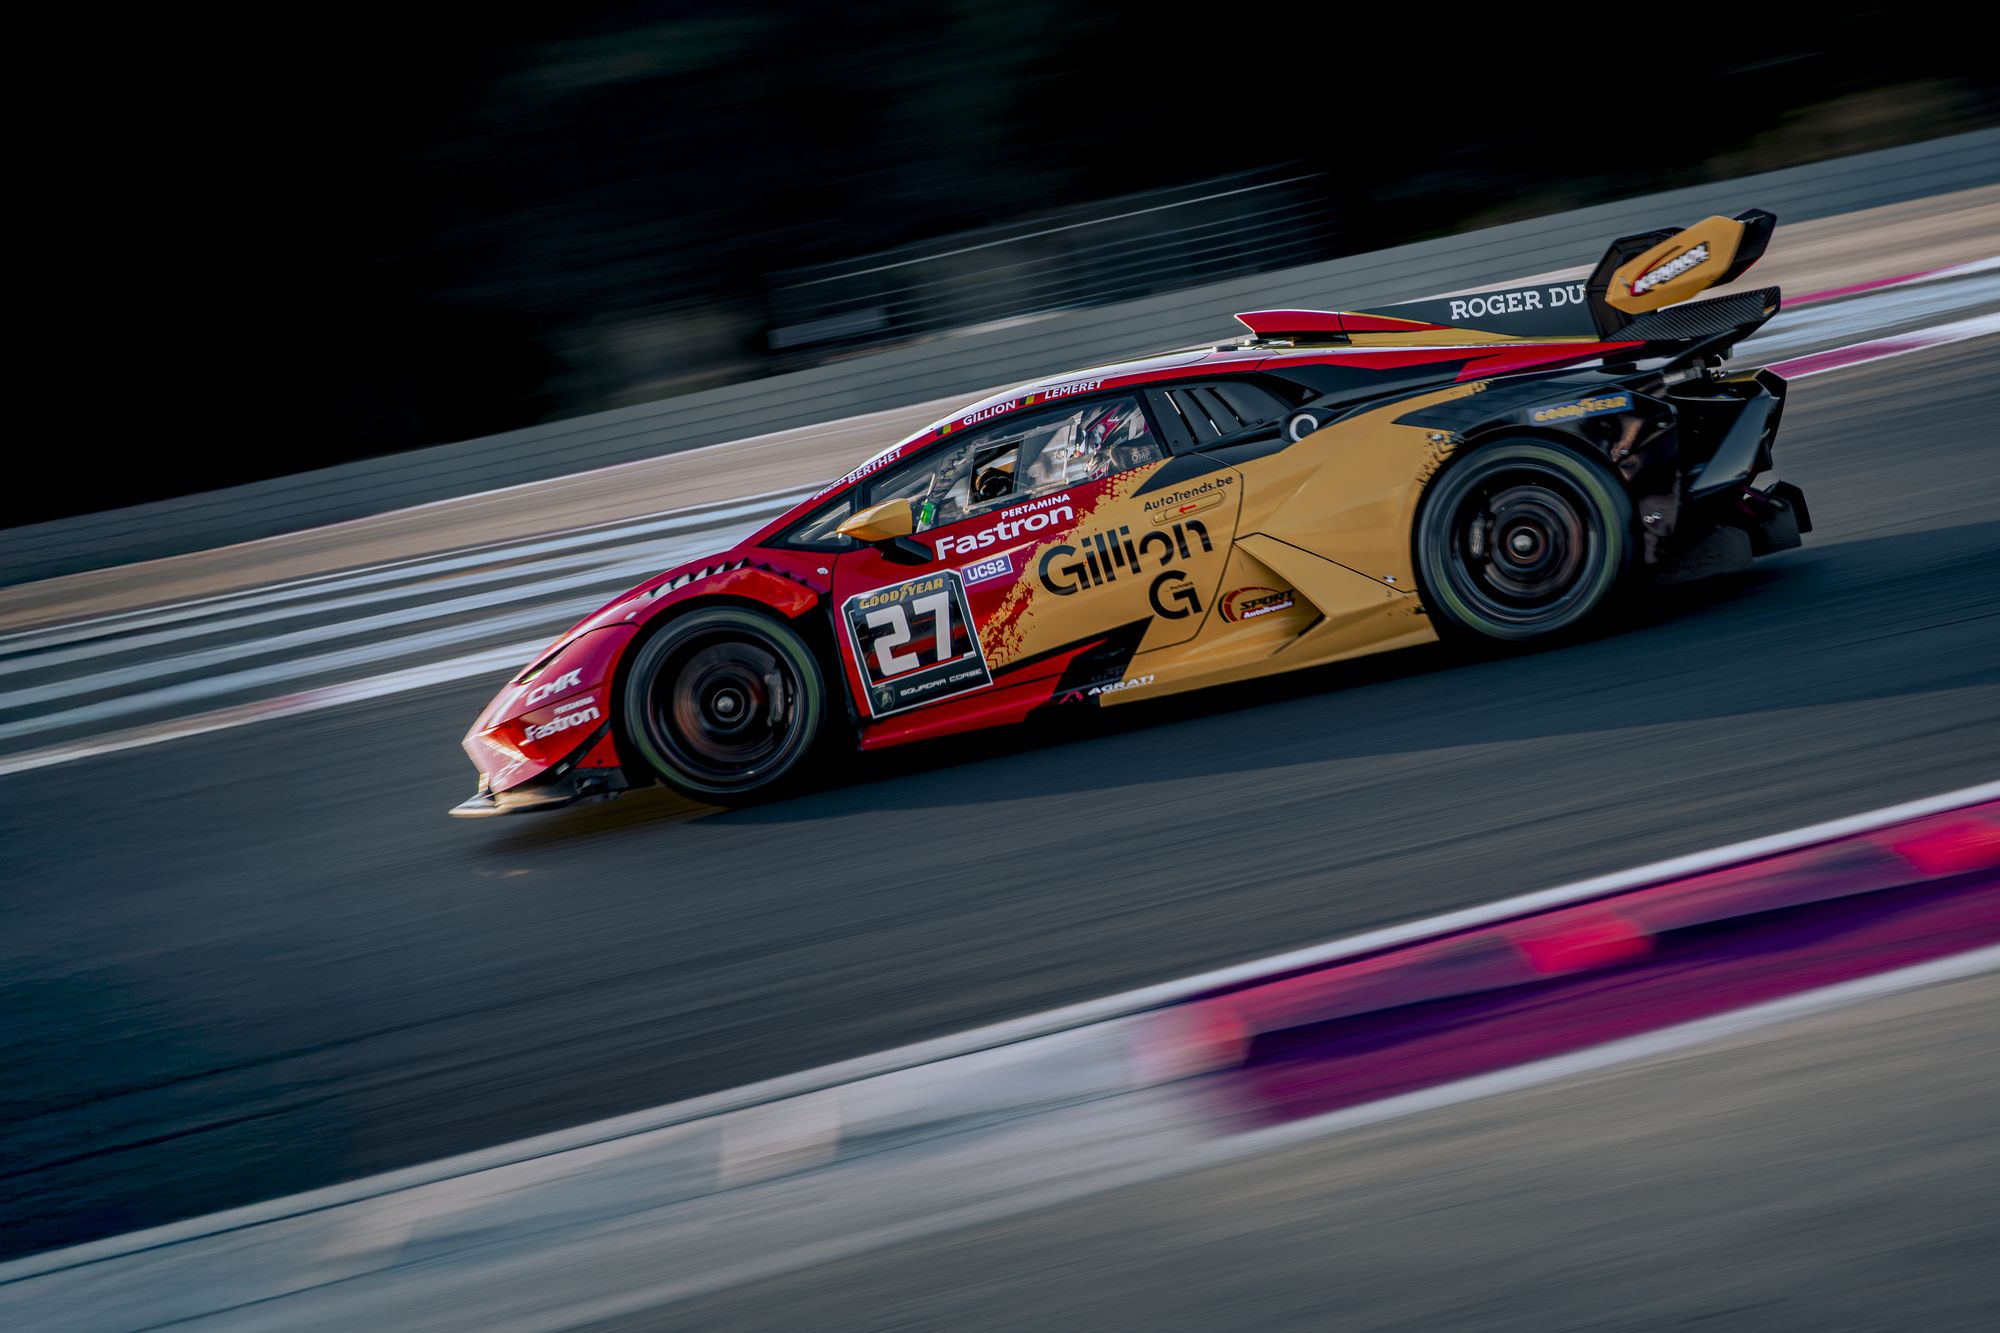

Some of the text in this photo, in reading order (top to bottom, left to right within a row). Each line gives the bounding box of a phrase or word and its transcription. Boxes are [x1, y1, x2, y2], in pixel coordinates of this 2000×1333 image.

[1450, 284, 1586, 320] ROGER DU
[1044, 379, 1104, 400] LEMERET
[962, 400, 1016, 426] GILLION
[847, 447, 902, 484] BERTHET
[1132, 450, 1151, 463] OMP
[1001, 493, 1070, 520] PERTAMINA
[1143, 475, 1234, 512] AutoTrends.be
[935, 505, 1074, 561] Fastron
[967, 559, 1005, 581] UCS2
[1038, 519, 1213, 596] Gillion
[859, 577, 944, 609] GOODYEAR
[1240, 588, 1296, 610] SPORT
[865, 590, 952, 677] 27
[525, 667, 583, 707] CMR
[949, 667, 983, 683] CORSE
[1087, 674, 1155, 696] AGRATI
[518, 706, 601, 746] Fastron
